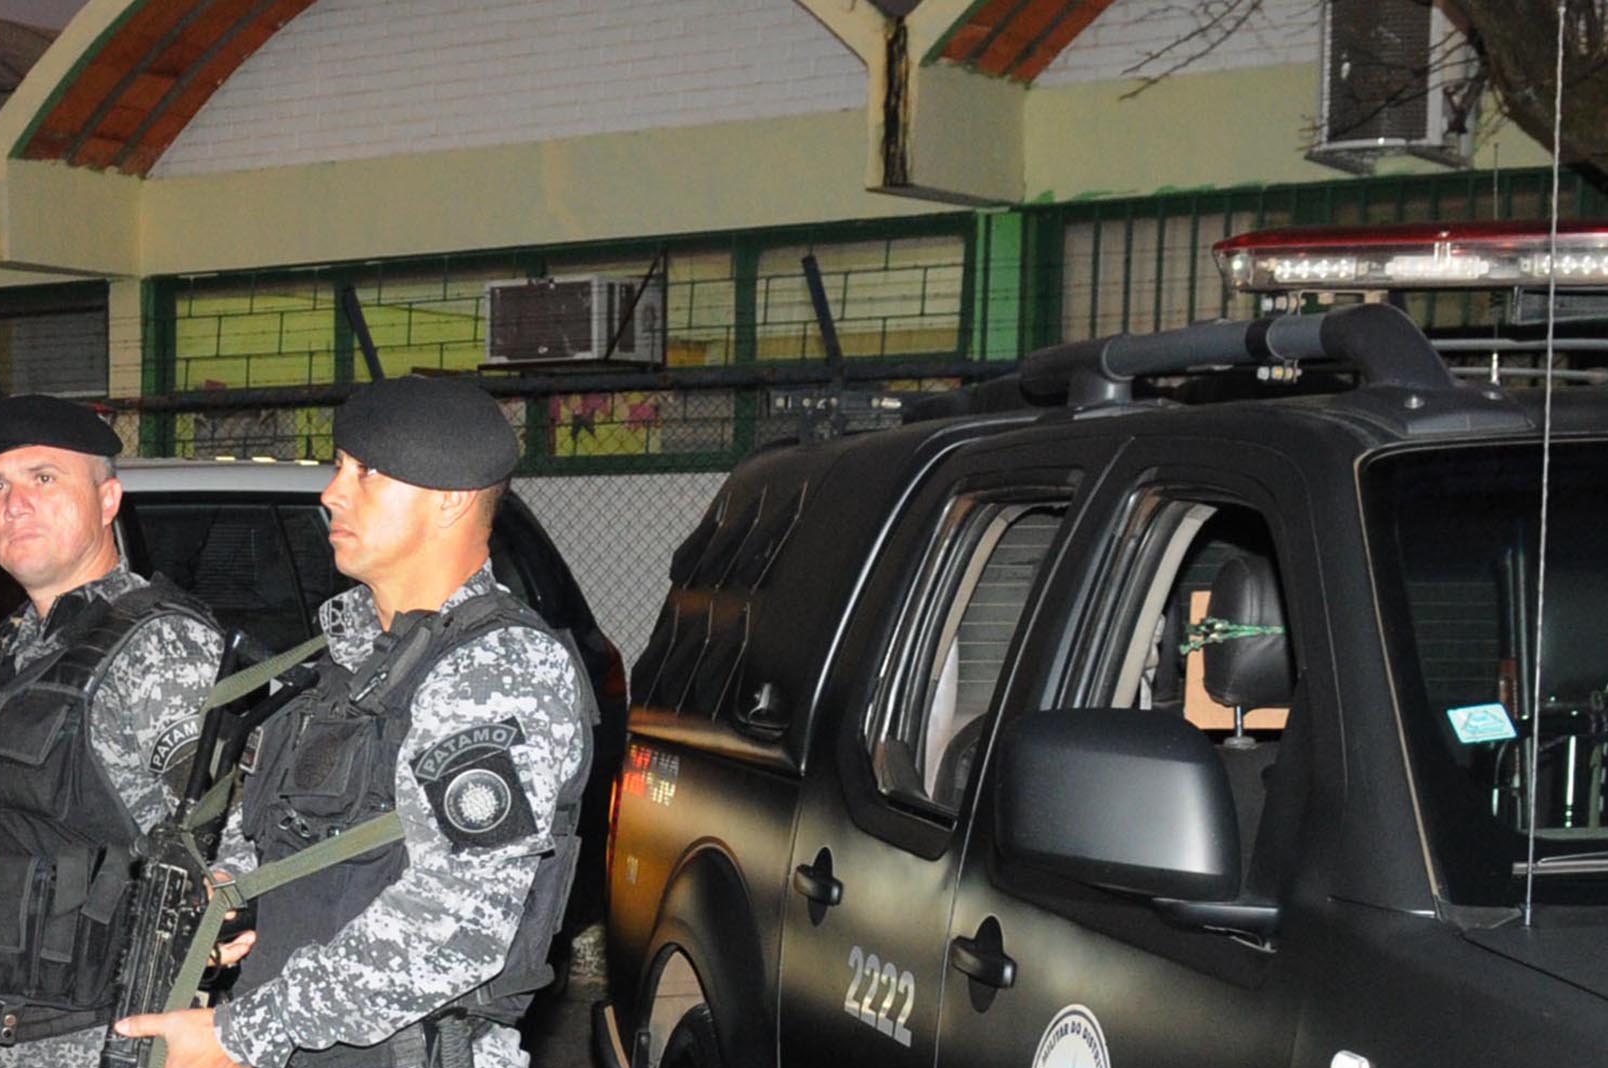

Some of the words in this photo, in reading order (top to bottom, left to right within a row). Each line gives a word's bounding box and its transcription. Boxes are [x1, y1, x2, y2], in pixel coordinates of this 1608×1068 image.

[152, 721, 198, 767] PATAM
[423, 728, 507, 772] PATAMO
[844, 945, 915, 1048] 2222
[1041, 1022, 1070, 1064] MILITAR
[1070, 1020, 1082, 1036] DO
